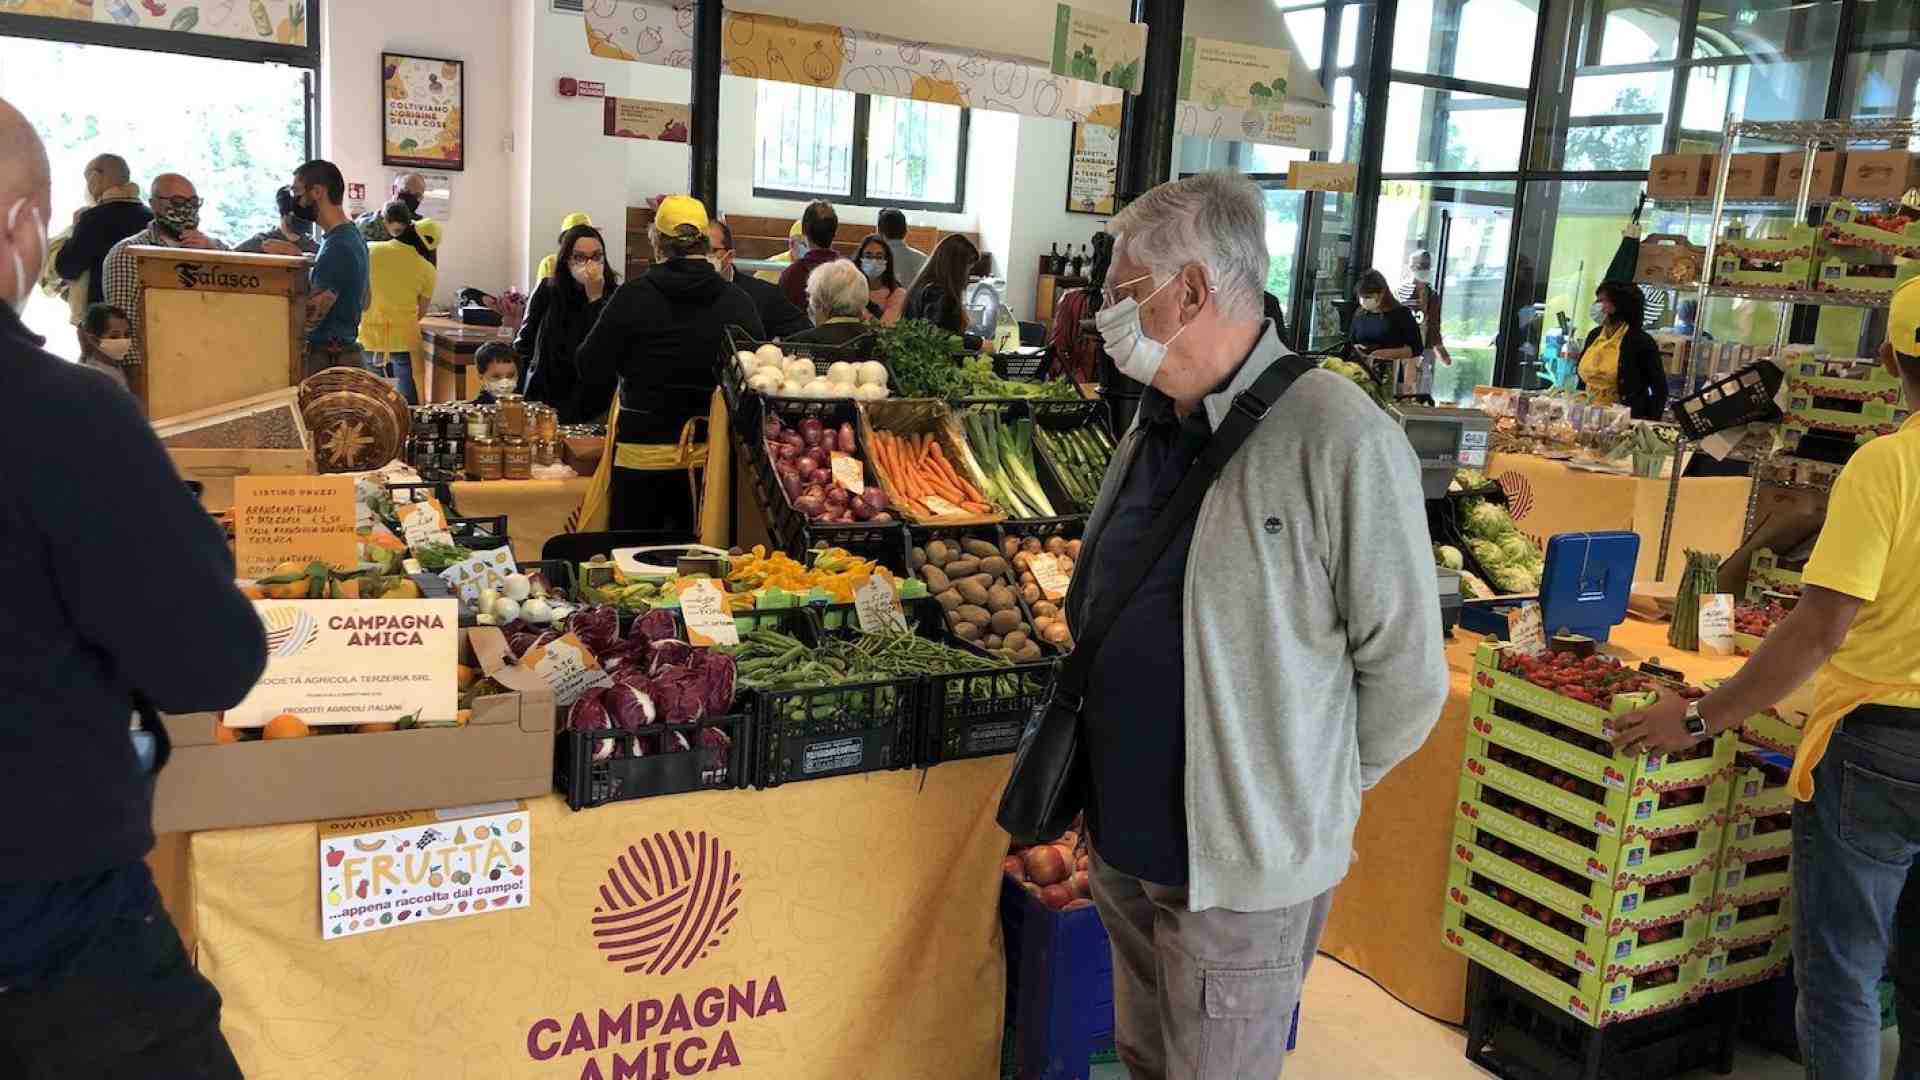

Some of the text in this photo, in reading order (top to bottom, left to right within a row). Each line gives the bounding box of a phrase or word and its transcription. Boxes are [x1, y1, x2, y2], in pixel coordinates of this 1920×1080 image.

[390, 101, 449, 112] COLTIVIAMO
[390, 118, 447, 128] DELLE COSE
[328, 615, 444, 631] CAMPAGNA
[347, 631, 424, 647] AMICA
[304, 676, 358, 685] AGRICOLA
[282, 706, 325, 714] PRODOTTI
[343, 838, 514, 900] FRUTTA
[395, 889, 450, 907] raccolta
[453, 885, 473, 899] dal
[476, 879, 524, 896] campo!
[526, 975, 787, 1062] CAMPAGNA
[578, 1029, 742, 1080] AMICA
